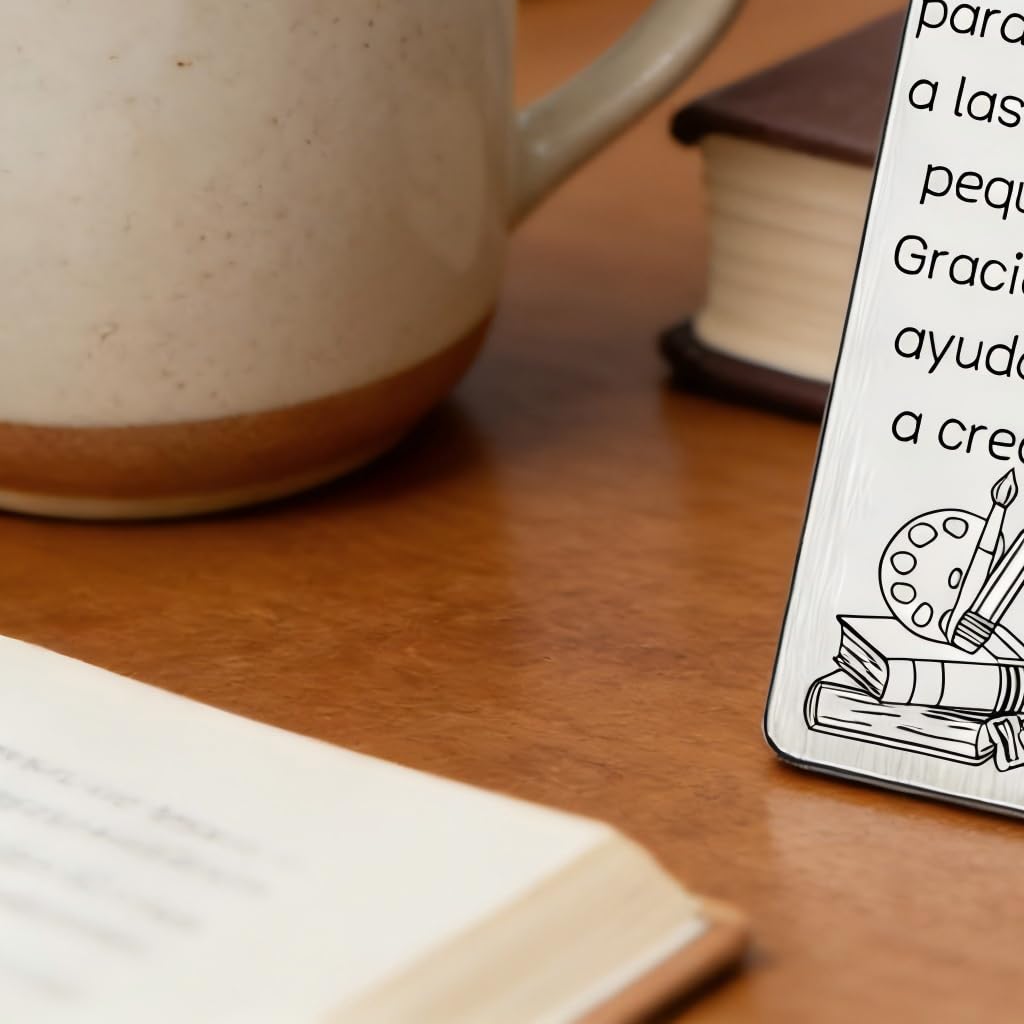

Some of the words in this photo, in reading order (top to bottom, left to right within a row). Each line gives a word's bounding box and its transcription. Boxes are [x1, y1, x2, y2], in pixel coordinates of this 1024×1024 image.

[908, 78, 939, 112] a
[953, 75, 1024, 128] las
[891, 410, 923, 445] a
